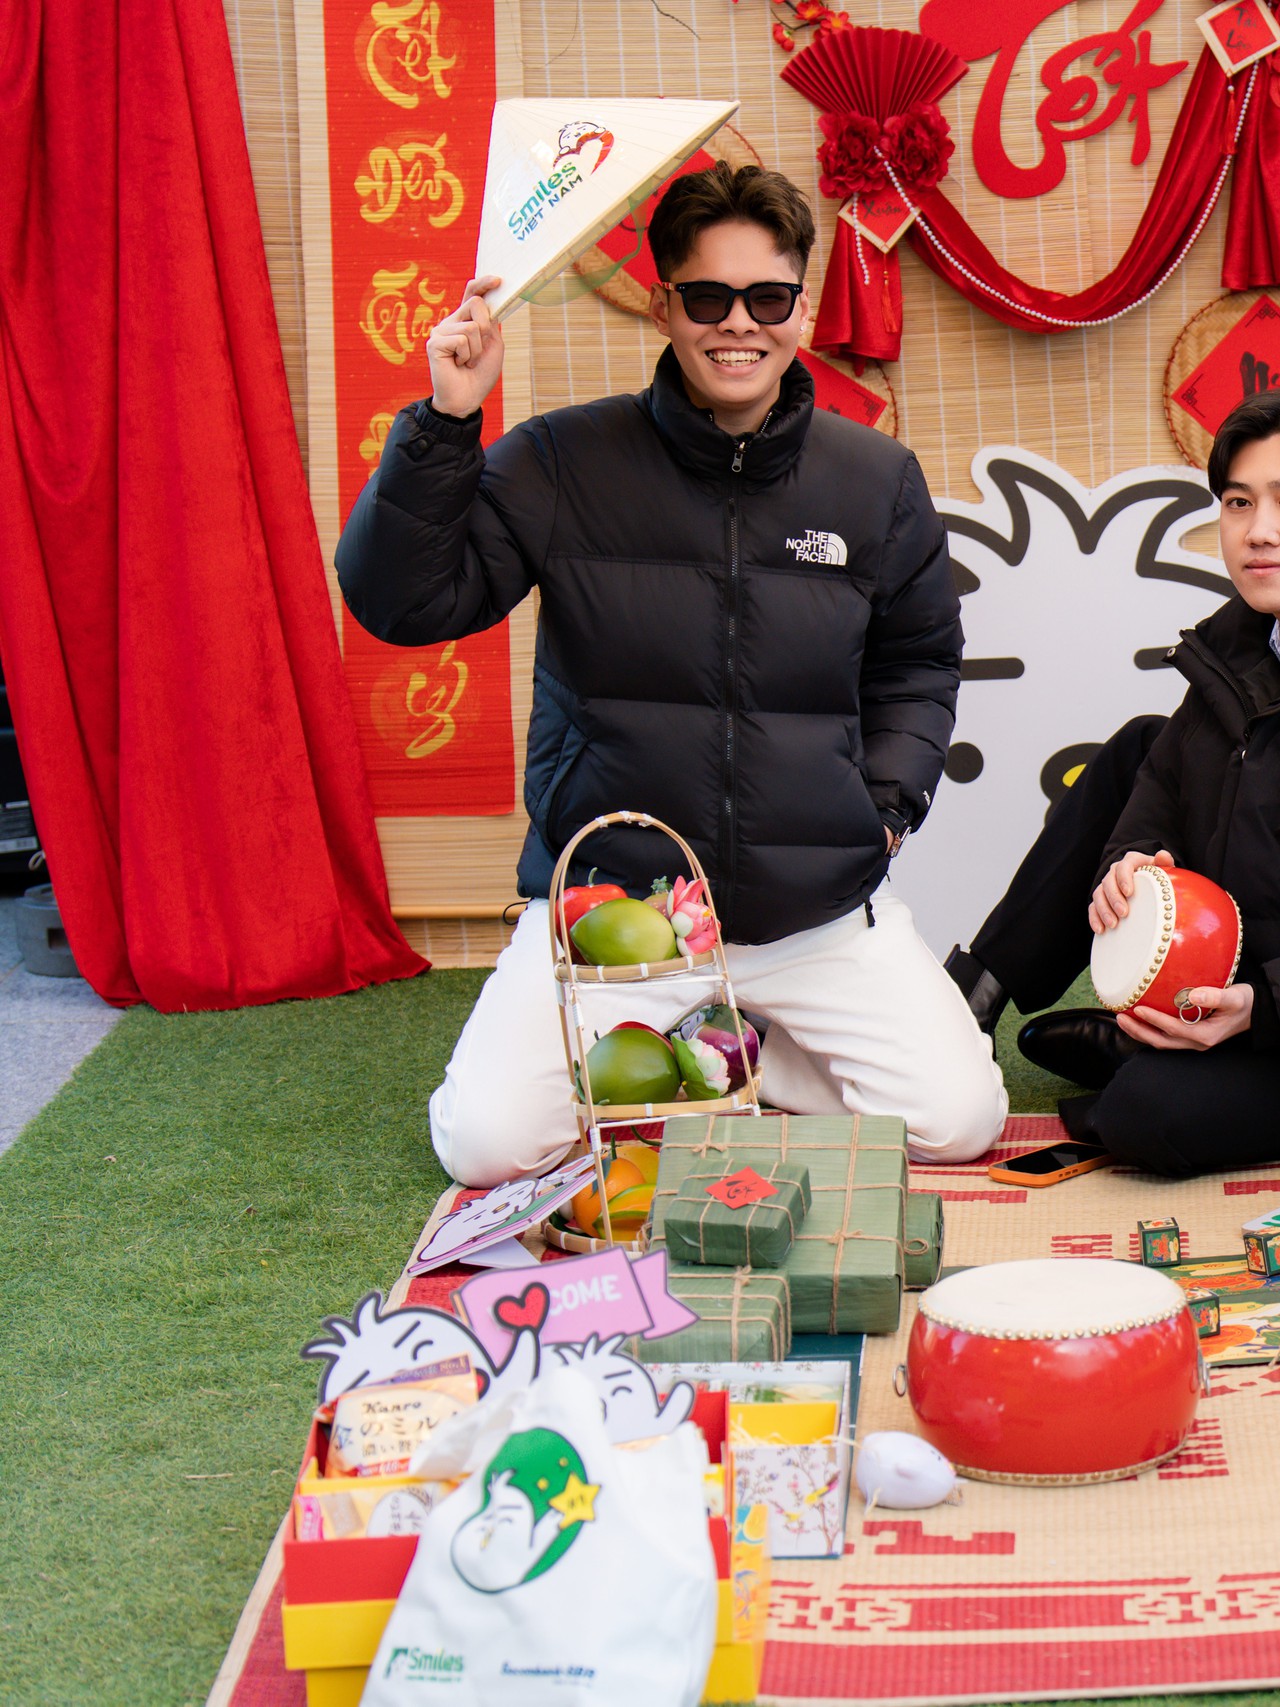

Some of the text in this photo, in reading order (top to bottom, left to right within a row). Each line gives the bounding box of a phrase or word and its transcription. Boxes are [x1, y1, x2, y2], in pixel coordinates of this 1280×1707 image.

[508, 161, 577, 234] Smiles
[548, 174, 583, 207] NAM
[785, 537, 827, 554] NORTH
[805, 529, 828, 543] THE
[795, 549, 826, 564] FACE
[548, 1274, 622, 1317] COME
